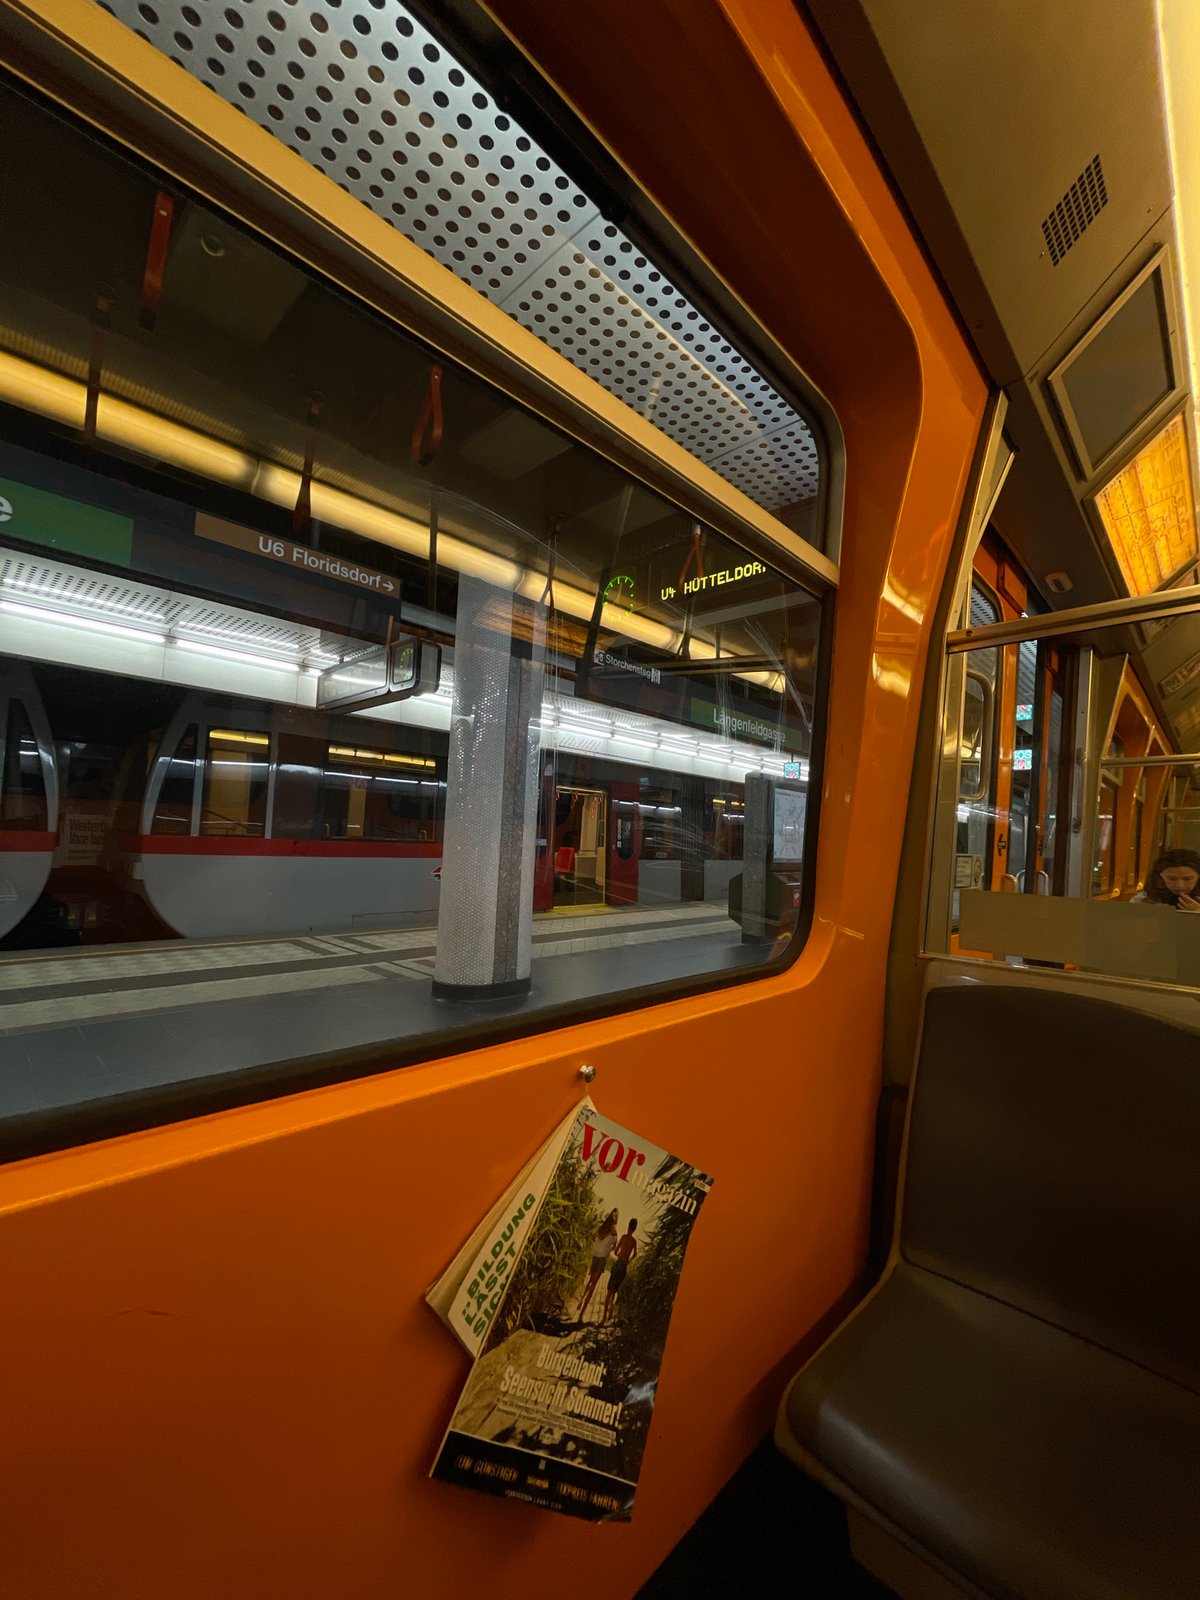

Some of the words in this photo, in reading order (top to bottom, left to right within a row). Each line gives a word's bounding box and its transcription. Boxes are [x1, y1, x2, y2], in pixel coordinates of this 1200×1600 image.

[258, 536, 285, 557] U6
[292, 547, 382, 588] Floridsdorf
[661, 586, 677, 601] U4
[605, 653, 651, 680] Storchensteg
[713, 707, 786, 742] Längenfeldgasse
[464, 1241, 516, 1326] LÄSST
[500, 1365, 568, 1408] Seensucht
[566, 1386, 623, 1428] Sommer!
